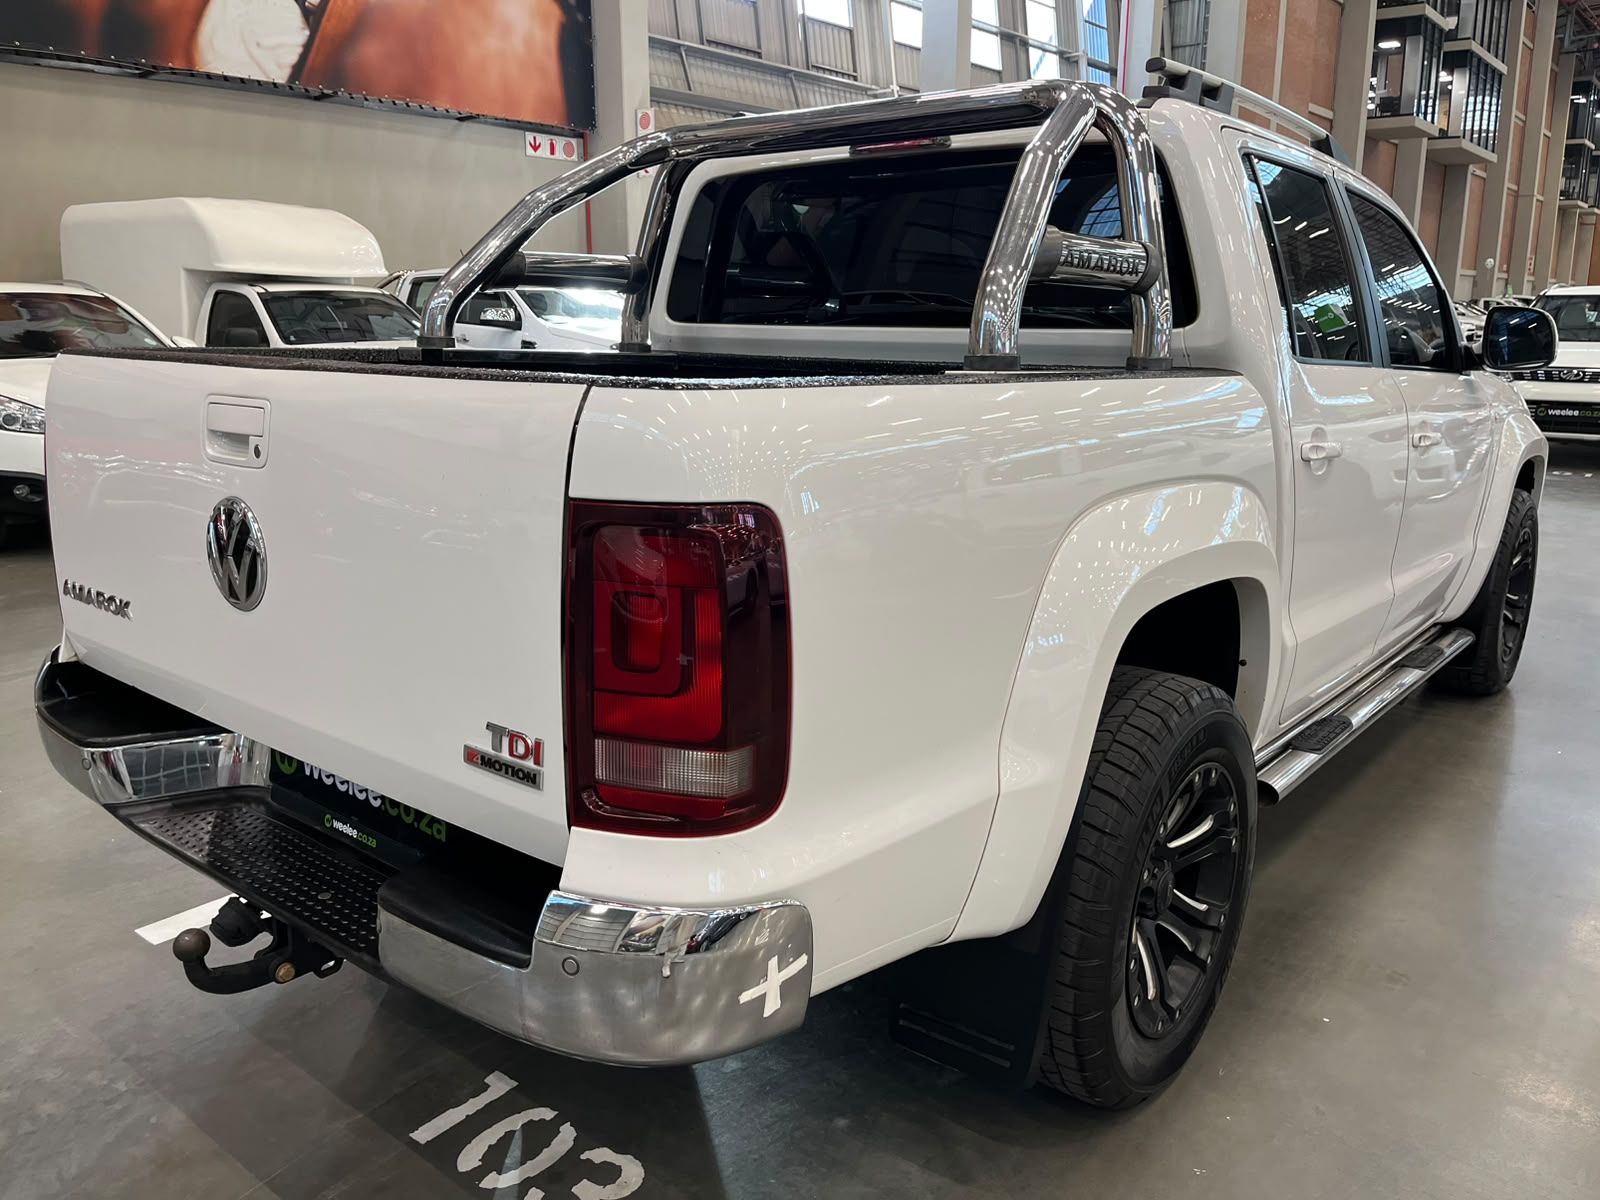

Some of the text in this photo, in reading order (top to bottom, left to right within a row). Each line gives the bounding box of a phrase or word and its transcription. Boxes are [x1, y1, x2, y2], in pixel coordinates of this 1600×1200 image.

[1060, 247, 1147, 277] AMAROK
[63, 579, 134, 622] AMAROK
[486, 721, 544, 768] TDI
[466, 749, 537, 785] 4MOTION
[332, 818, 377, 848] weelee.co.za
